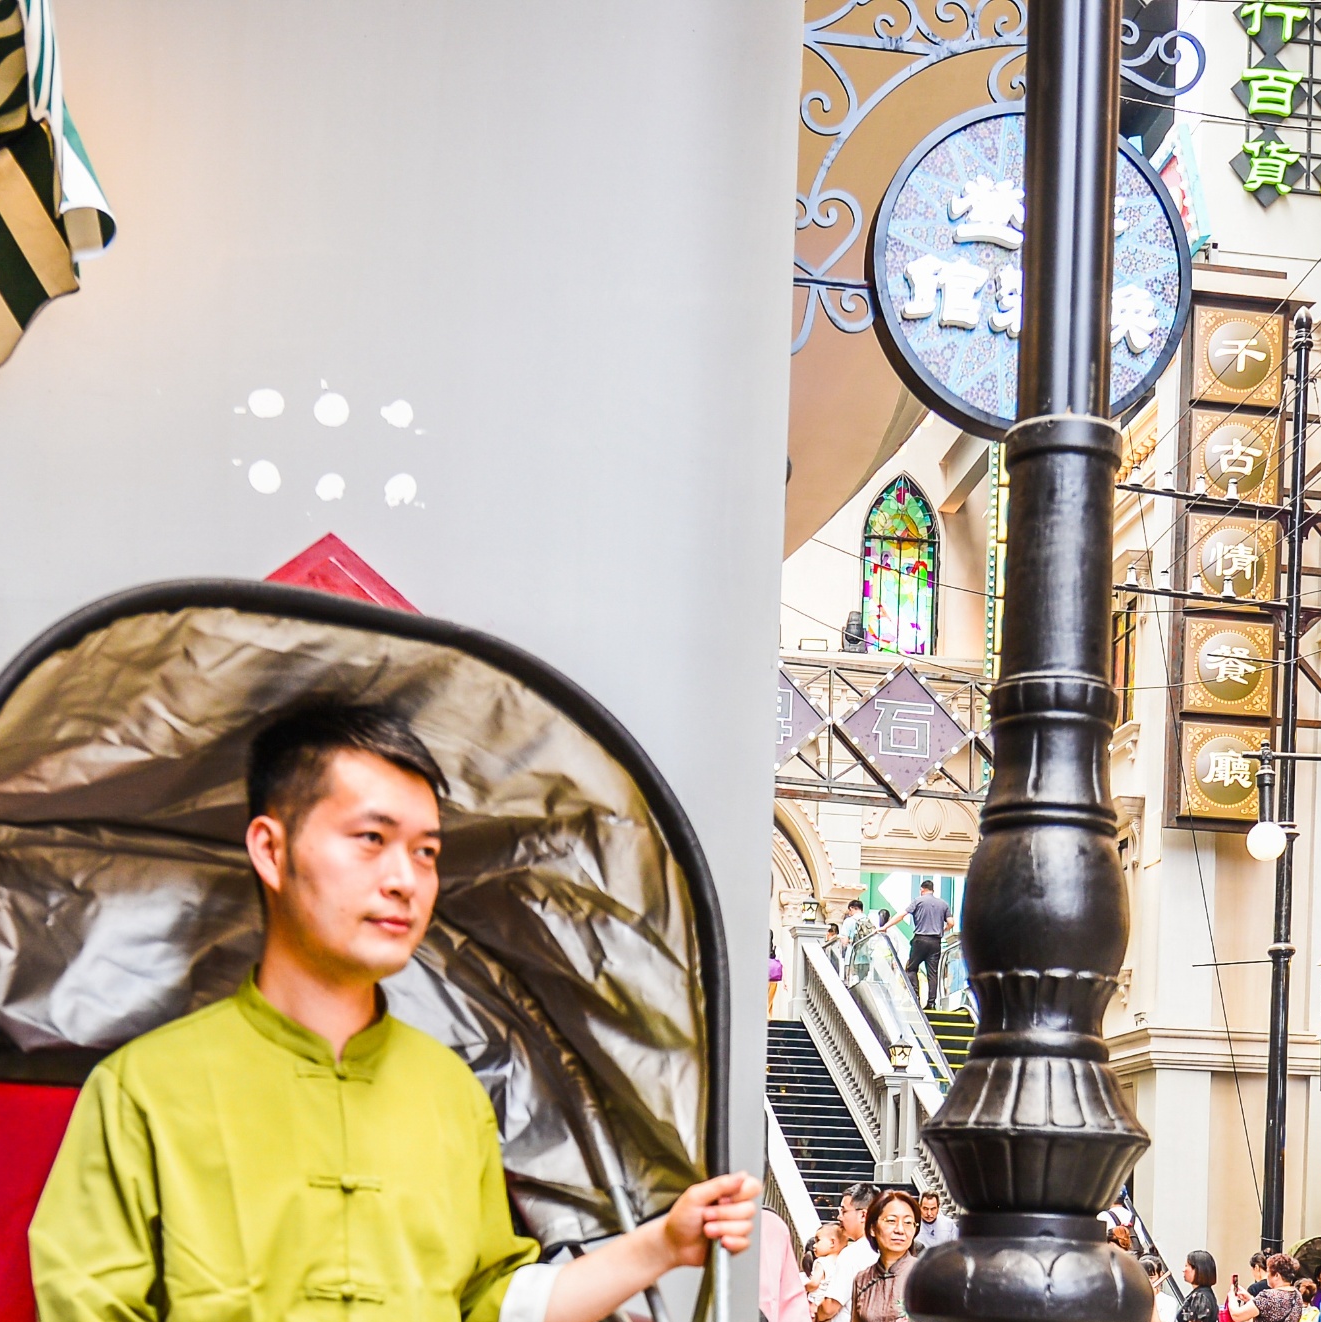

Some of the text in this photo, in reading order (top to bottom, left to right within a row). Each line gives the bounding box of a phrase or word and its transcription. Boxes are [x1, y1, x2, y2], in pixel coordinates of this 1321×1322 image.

[1201, 338, 1267, 788] 千古情餐廳
